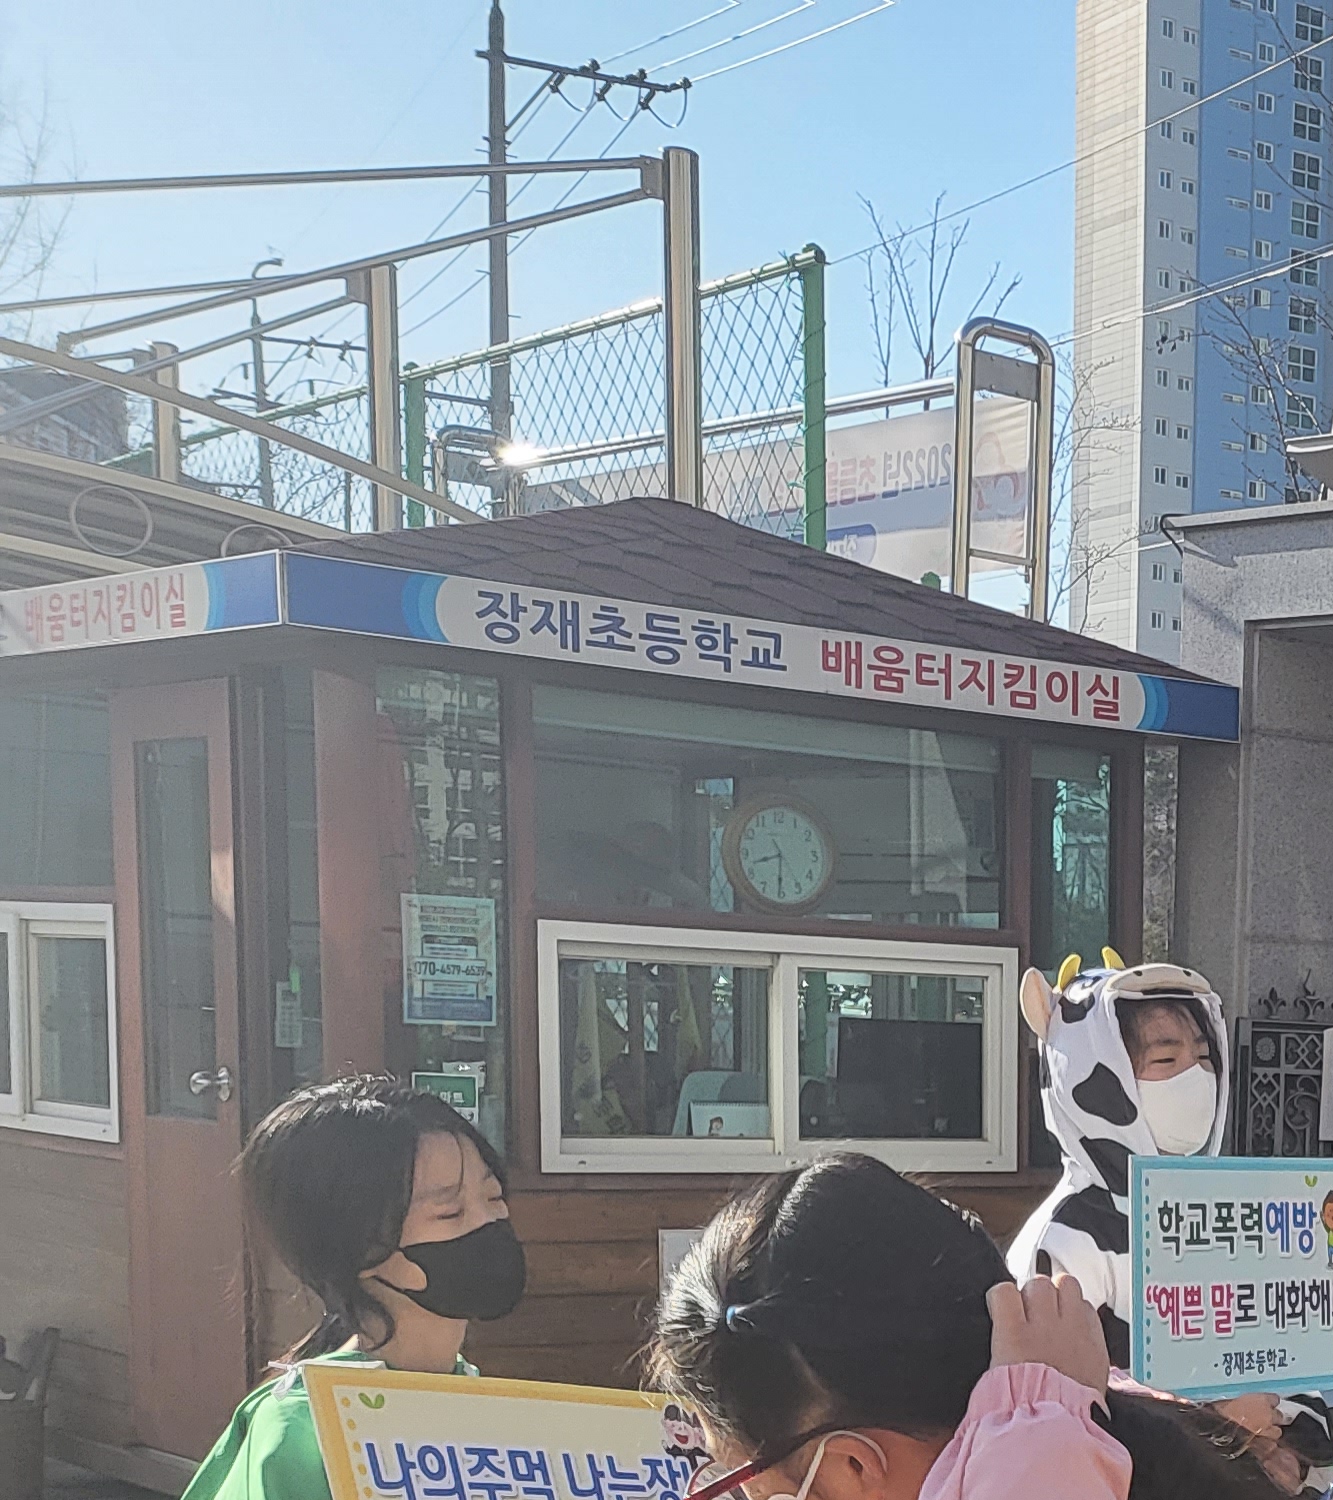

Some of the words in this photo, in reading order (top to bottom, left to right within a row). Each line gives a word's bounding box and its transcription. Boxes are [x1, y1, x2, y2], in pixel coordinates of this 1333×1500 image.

[25, 573, 187, 644] 배움터지킴이실
[475, 588, 788, 673] 장재초등학교
[820, 639, 1121, 722] 배움터지킴이실
[1157, 1201, 1317, 1258] 학교폭력예방
[1211, 1282, 1257, 1334] 말로
[1221, 1348, 1288, 1376] 장재초등학교
